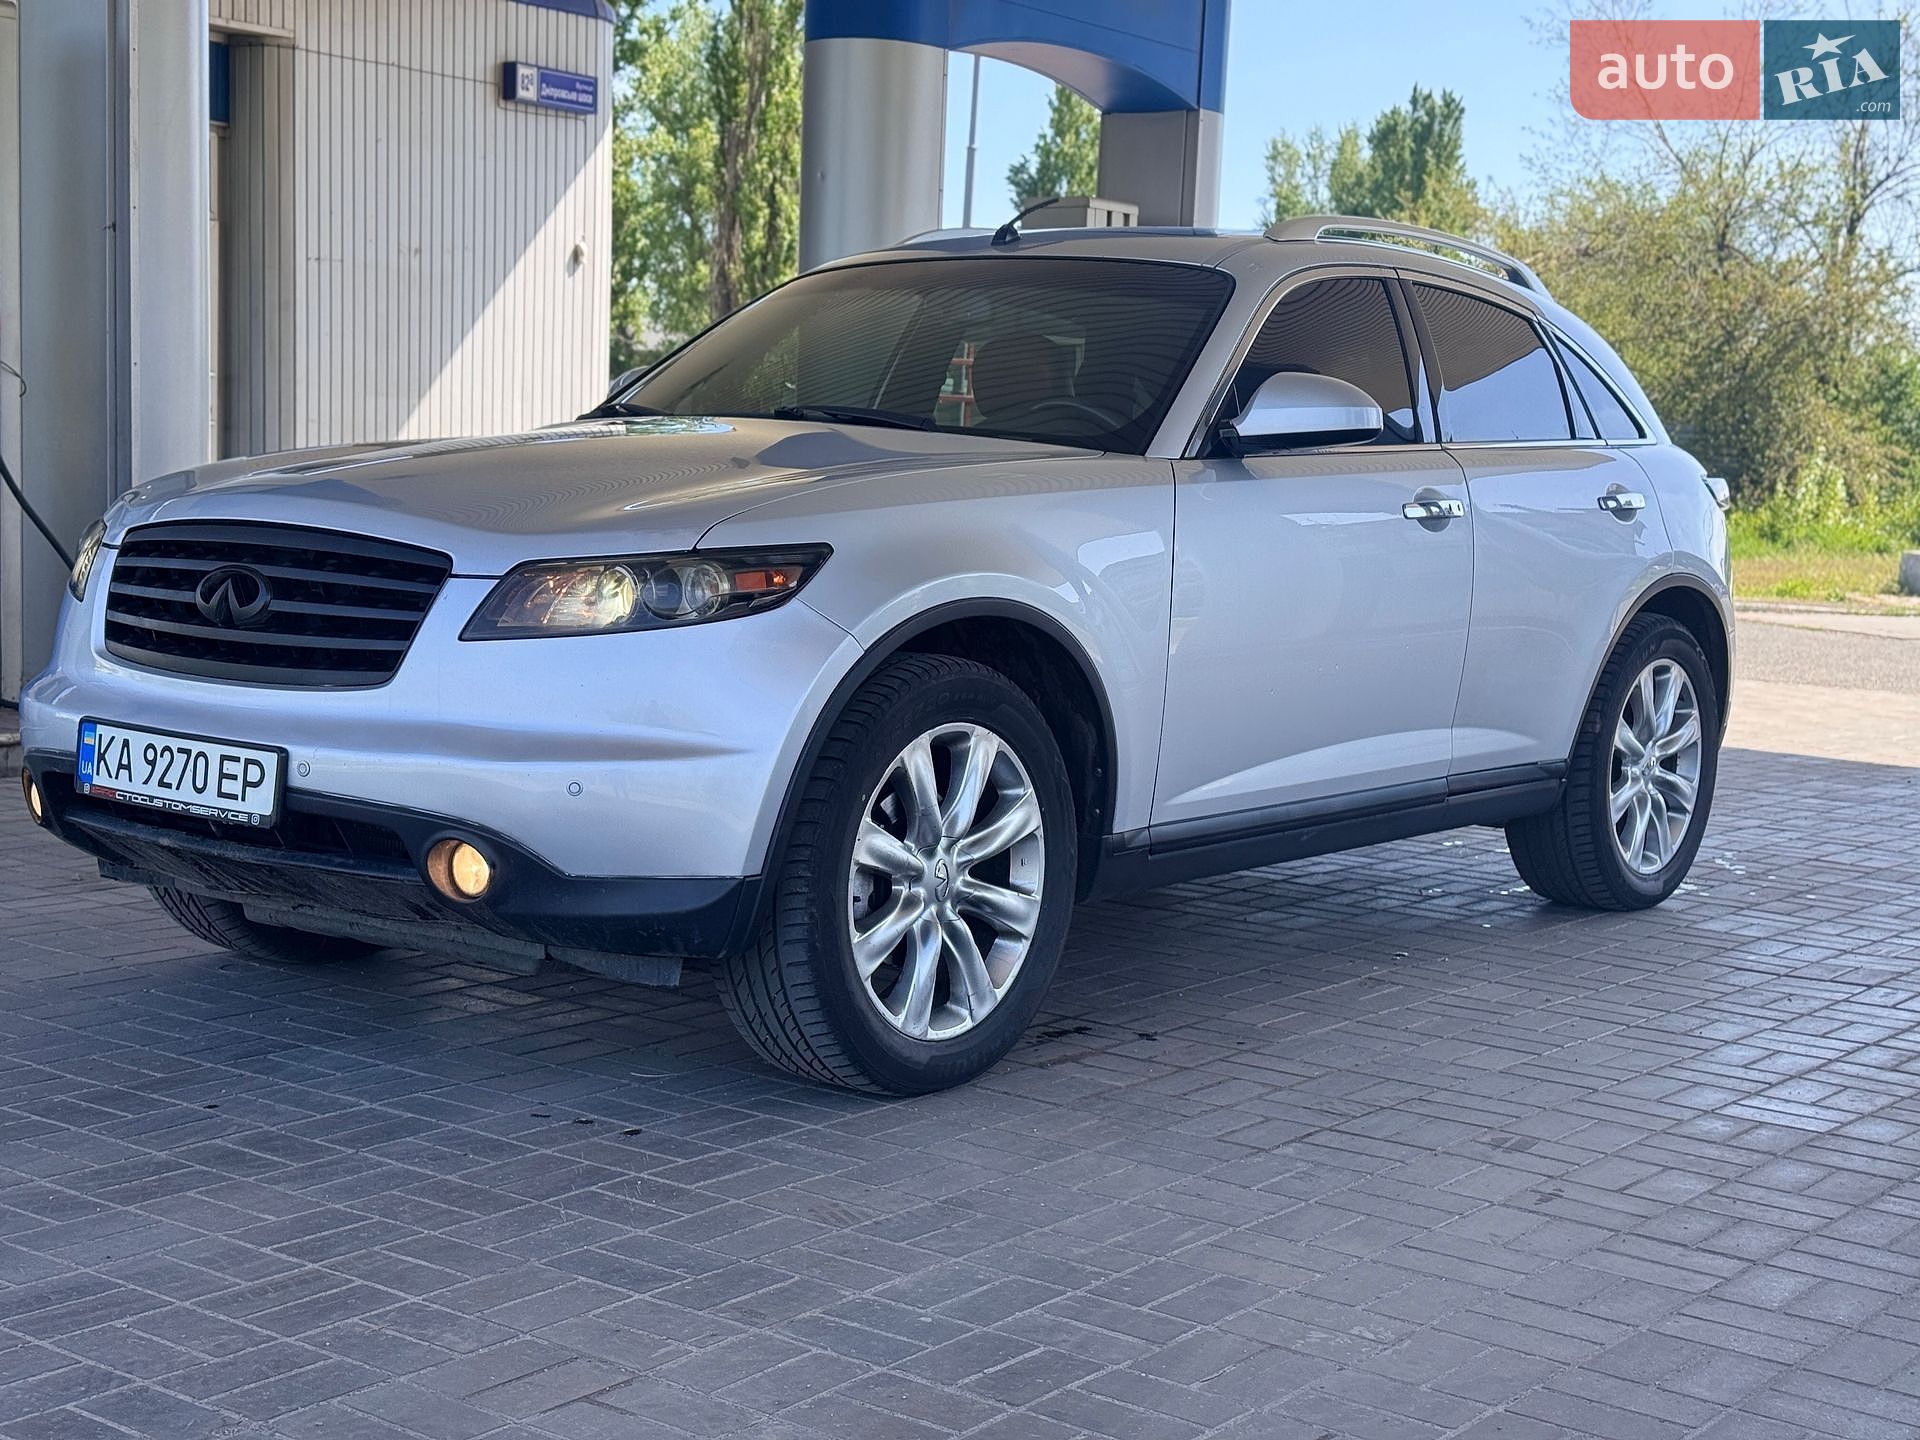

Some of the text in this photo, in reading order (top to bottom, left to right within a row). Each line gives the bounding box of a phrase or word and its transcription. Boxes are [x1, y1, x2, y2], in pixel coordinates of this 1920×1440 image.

[81, 760, 93, 776] UA
[95, 733, 266, 801] KA 9270 EP
